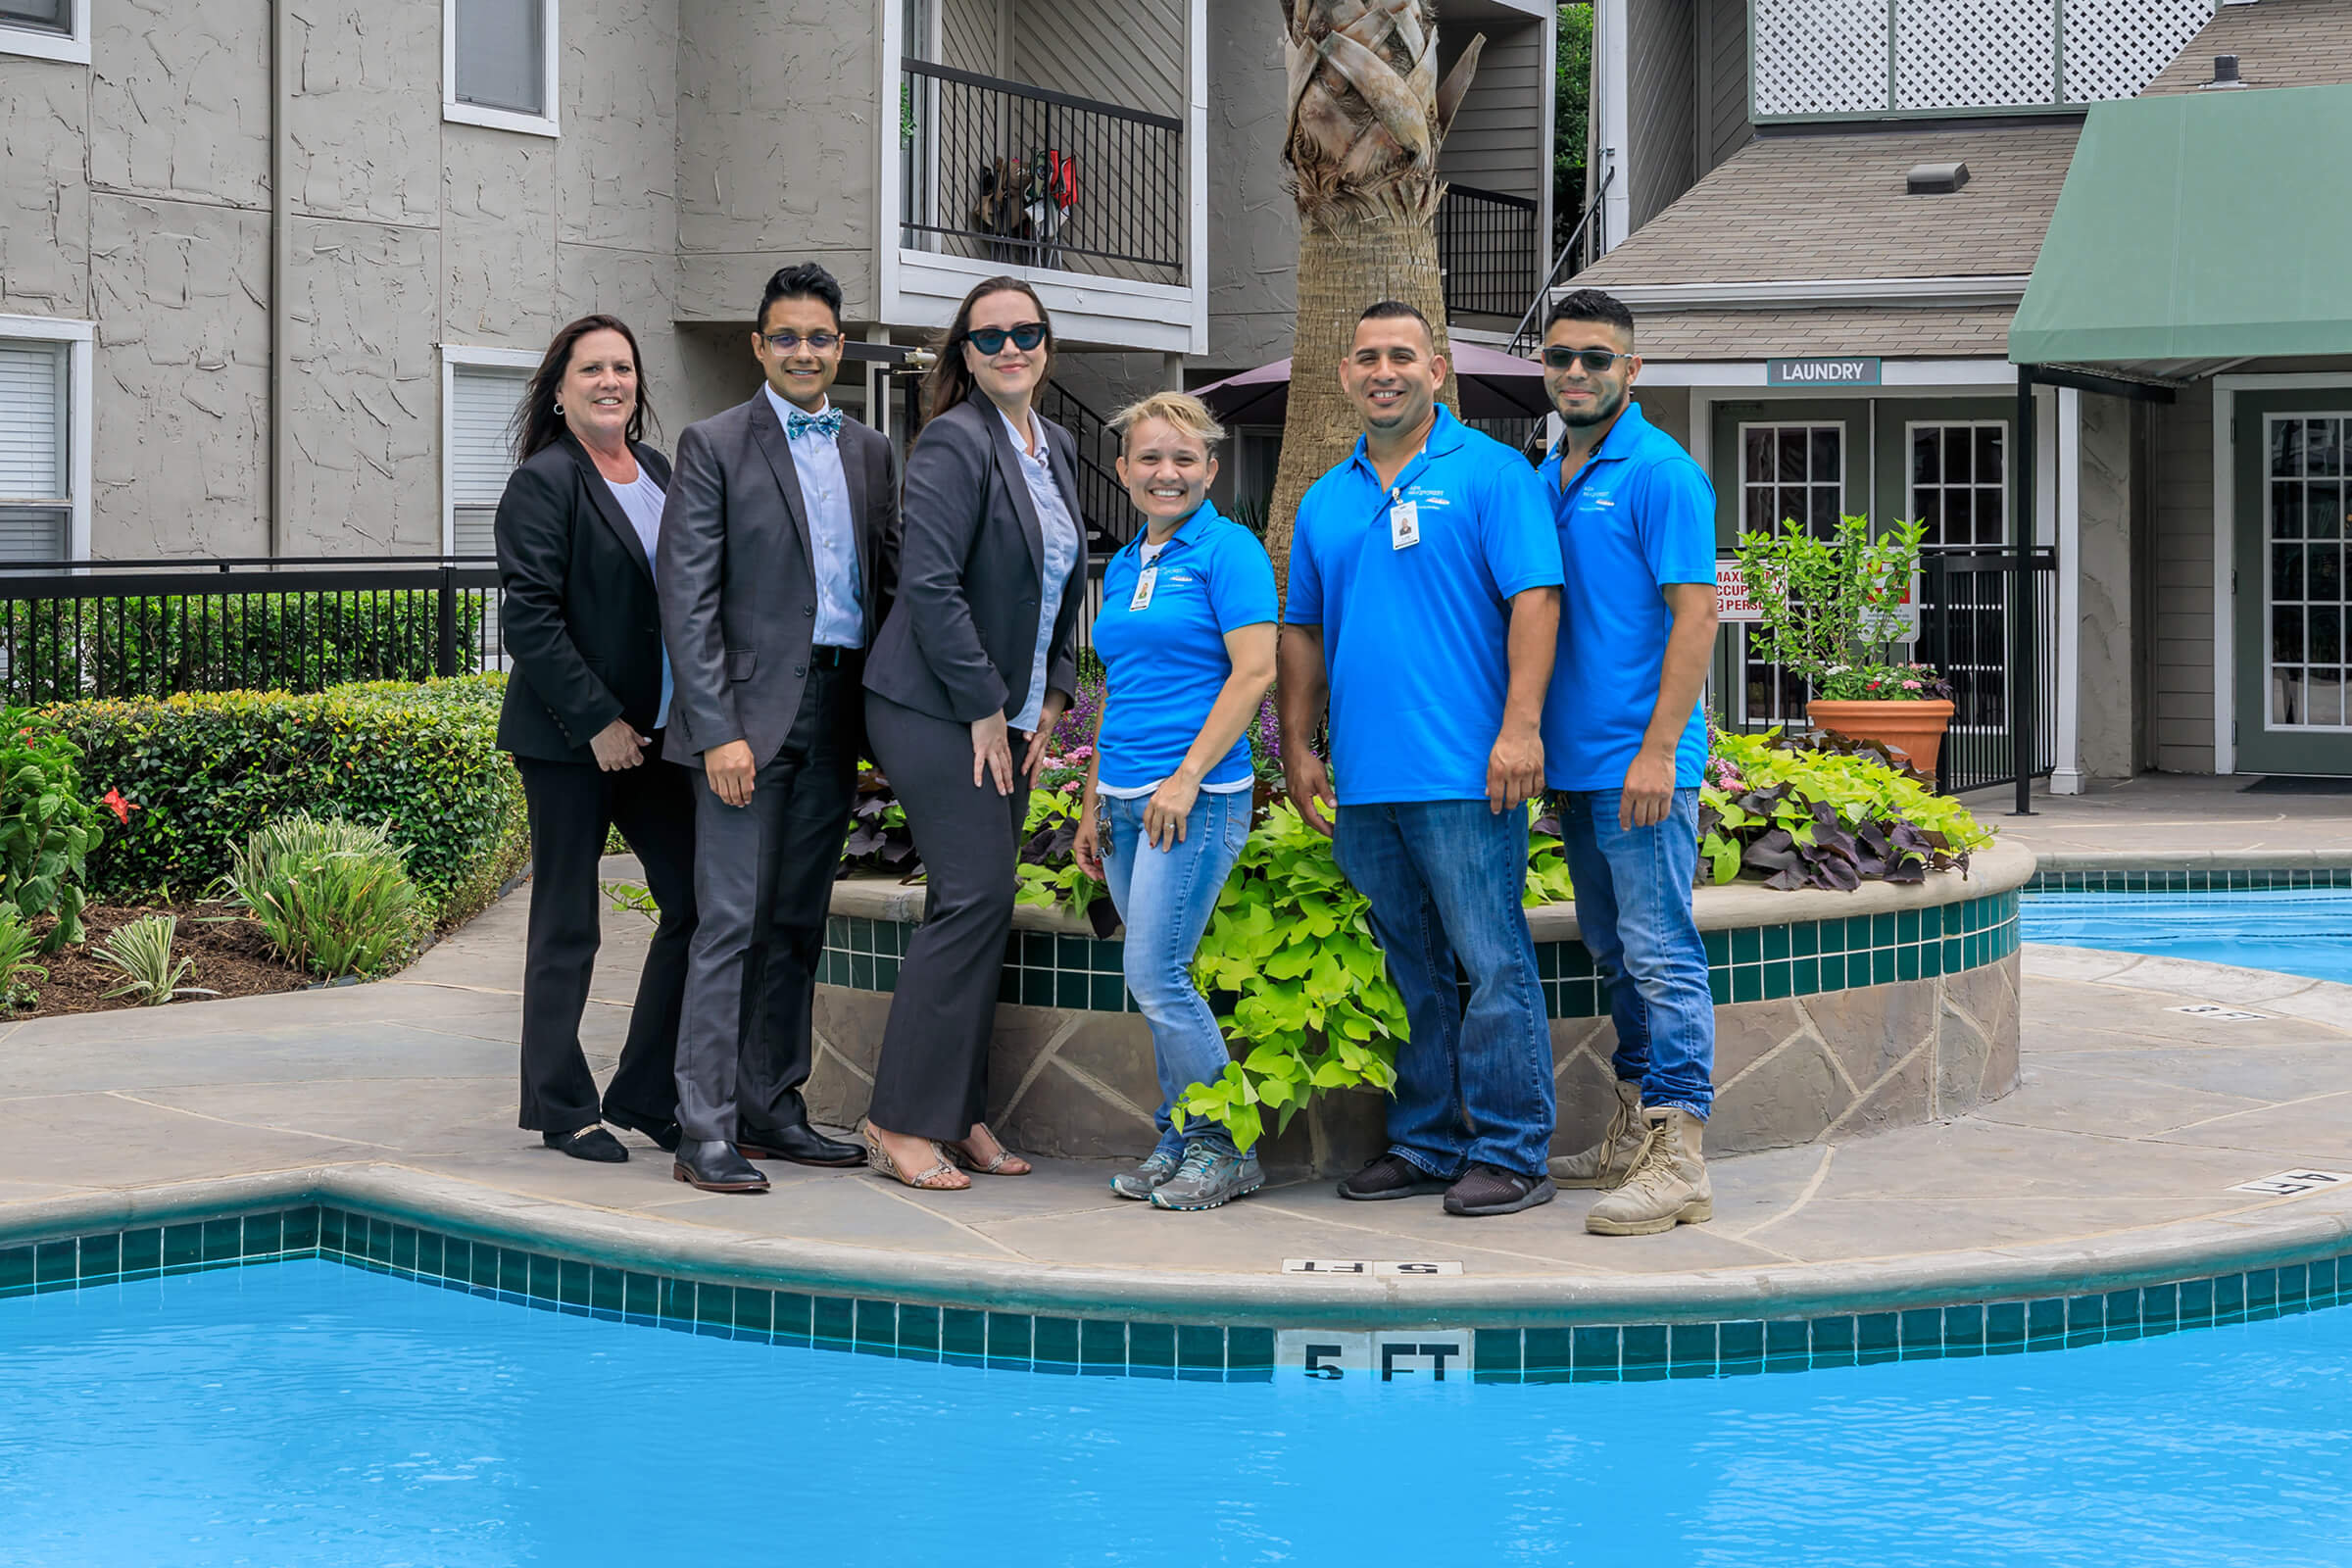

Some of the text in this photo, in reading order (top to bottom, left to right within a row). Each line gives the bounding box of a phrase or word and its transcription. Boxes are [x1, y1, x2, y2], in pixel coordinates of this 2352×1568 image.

[1782, 363, 1864, 380] LAUNDRY
[2240, 1173, 2339, 1195] 4 FT
[1291, 1261, 1438, 1274] 5 FT
[1304, 1344, 1459, 1382] 5 FT
